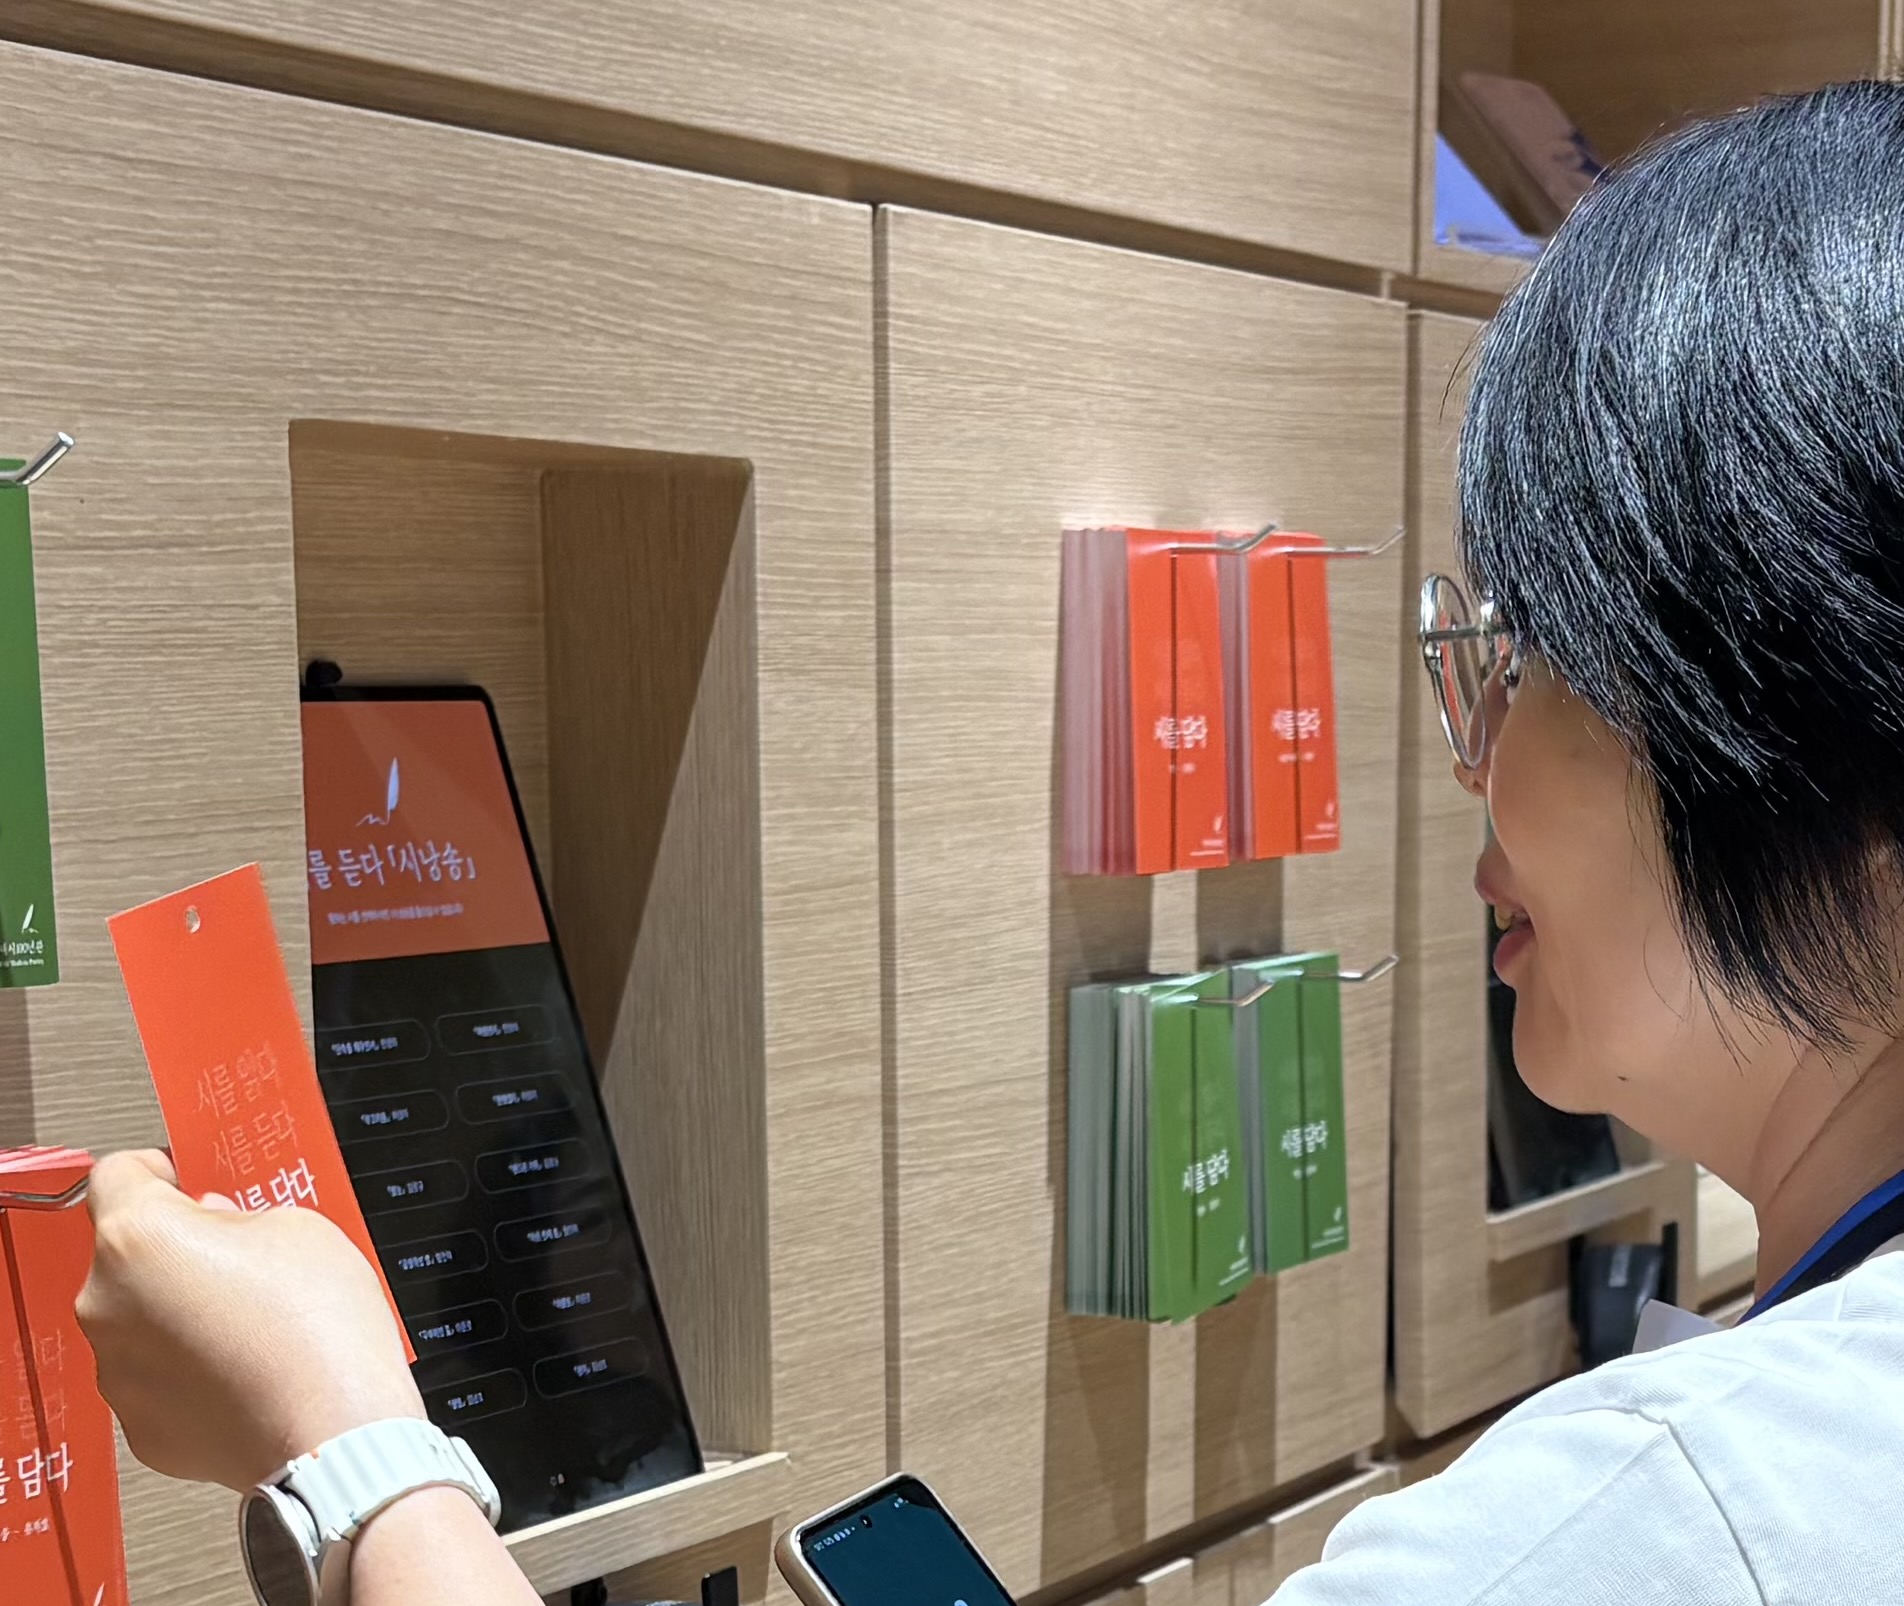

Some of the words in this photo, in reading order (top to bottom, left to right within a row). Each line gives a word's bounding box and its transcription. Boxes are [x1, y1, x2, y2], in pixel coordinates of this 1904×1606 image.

[307, 850, 333, 890] 를
[195, 1063, 239, 1120] 시를
[212, 1124, 256, 1180] 시를
[252, 1099, 298, 1162] 듣다
[16, 1441, 74, 1500] 담다
